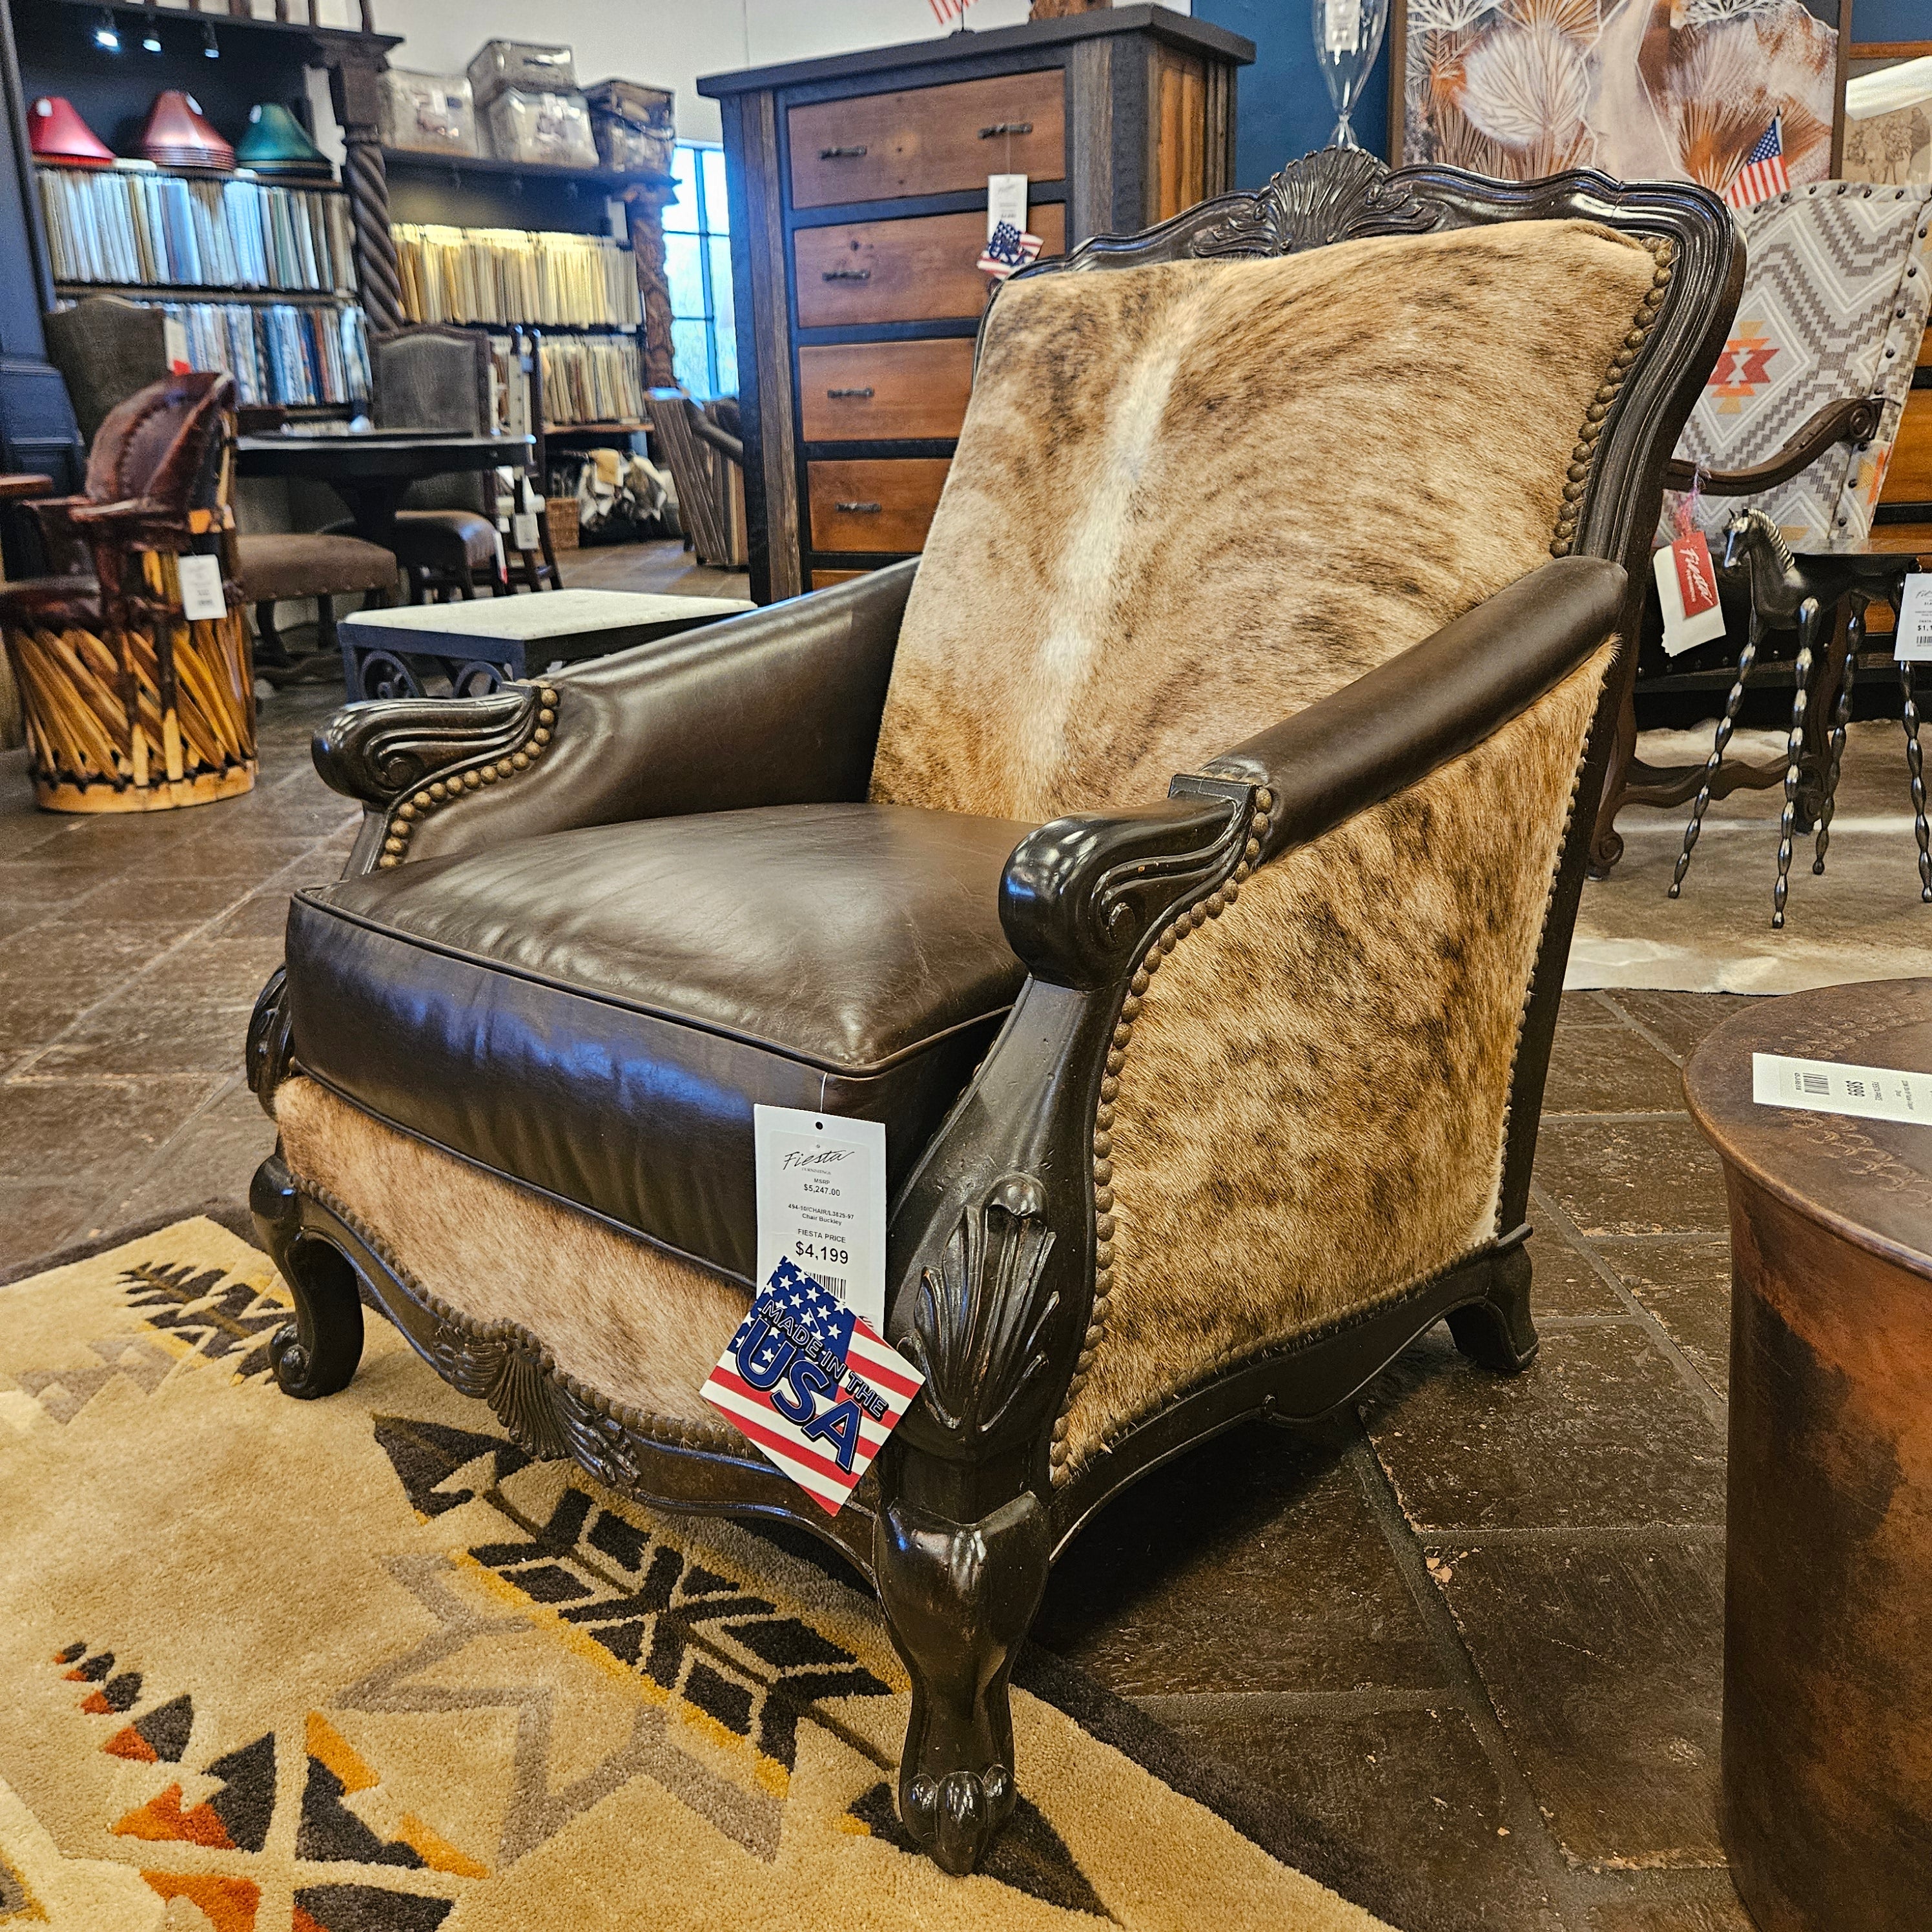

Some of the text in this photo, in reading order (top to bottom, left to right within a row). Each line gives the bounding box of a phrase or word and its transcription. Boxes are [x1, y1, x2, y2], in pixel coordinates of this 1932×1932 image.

[1845, 1080, 1865, 1097] $899
[783, 1150, 855, 1170] Fiesta
[803, 1183, 841, 1197] $5,247.00
[819, 1216, 842, 1226] Buckley
[797, 1228, 846, 1244] FIESTA PRICE
[796, 1240, 848, 1264] $4,199
[761, 1299, 889, 1423] MADE IN THE
[735, 1314, 862, 1475] USA
